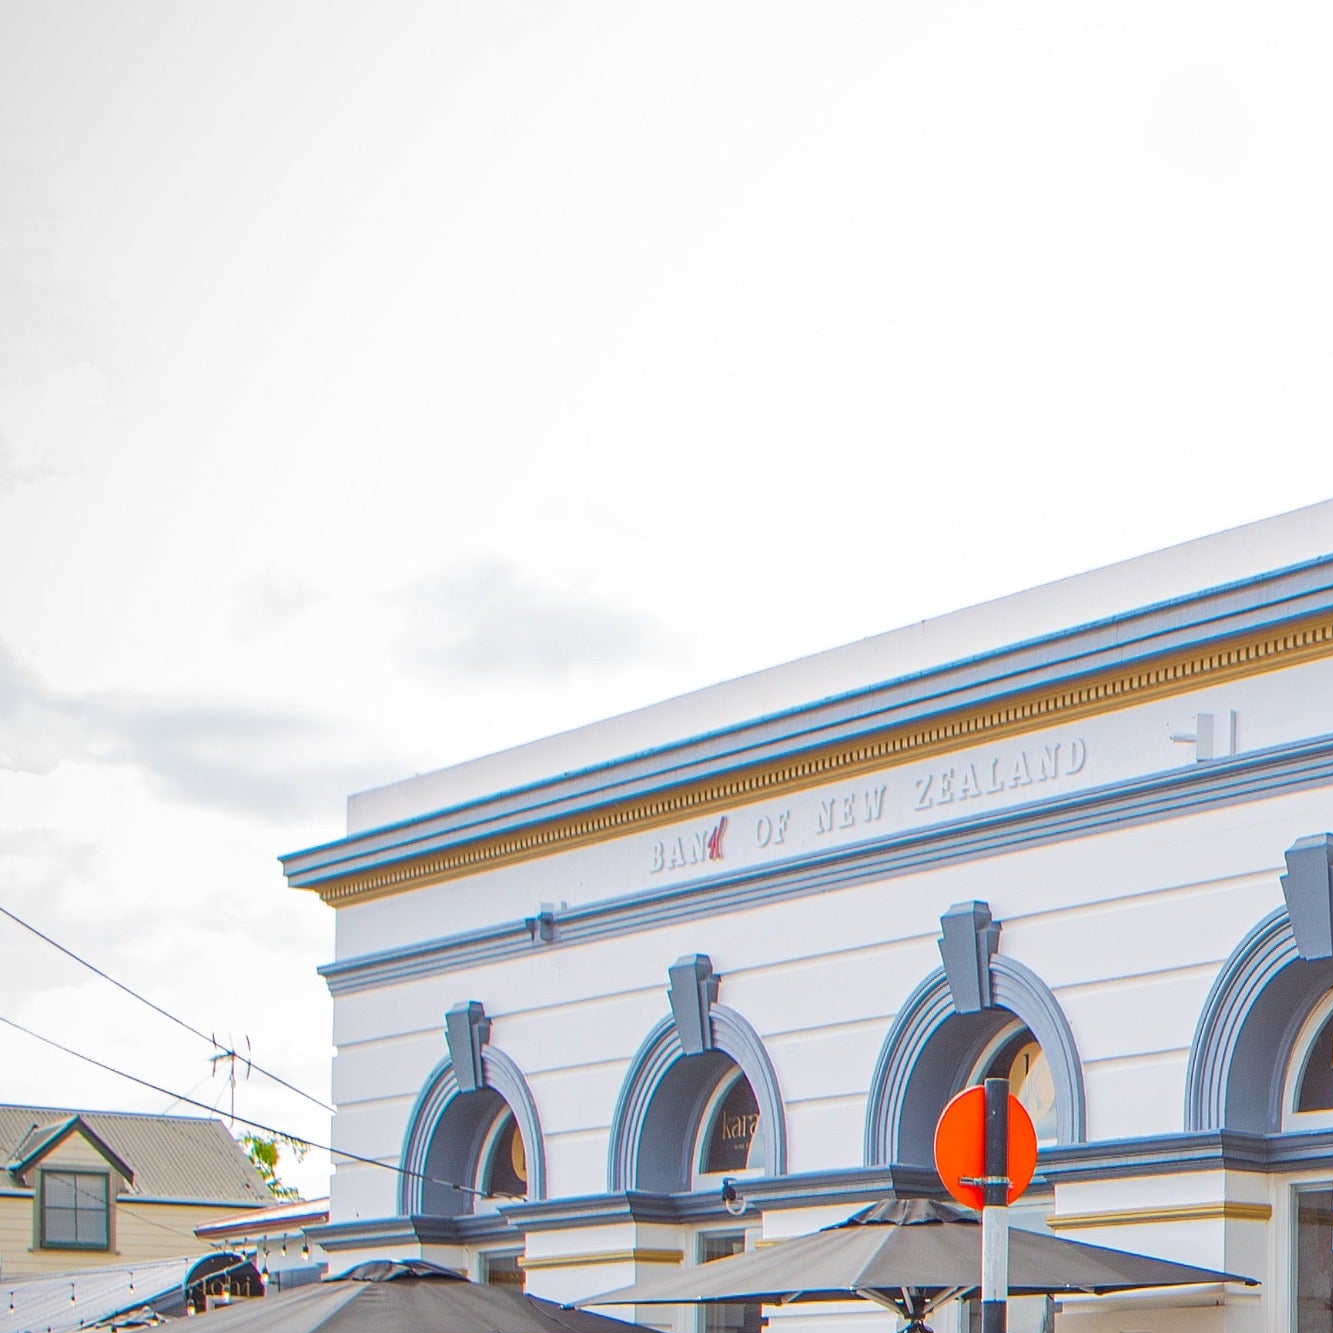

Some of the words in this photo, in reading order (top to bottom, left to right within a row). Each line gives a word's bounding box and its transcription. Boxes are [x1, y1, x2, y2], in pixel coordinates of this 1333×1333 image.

[756, 810, 791, 848] OF
[815, 784, 887, 834] NEW
[914, 738, 1086, 811] ZEALAND
